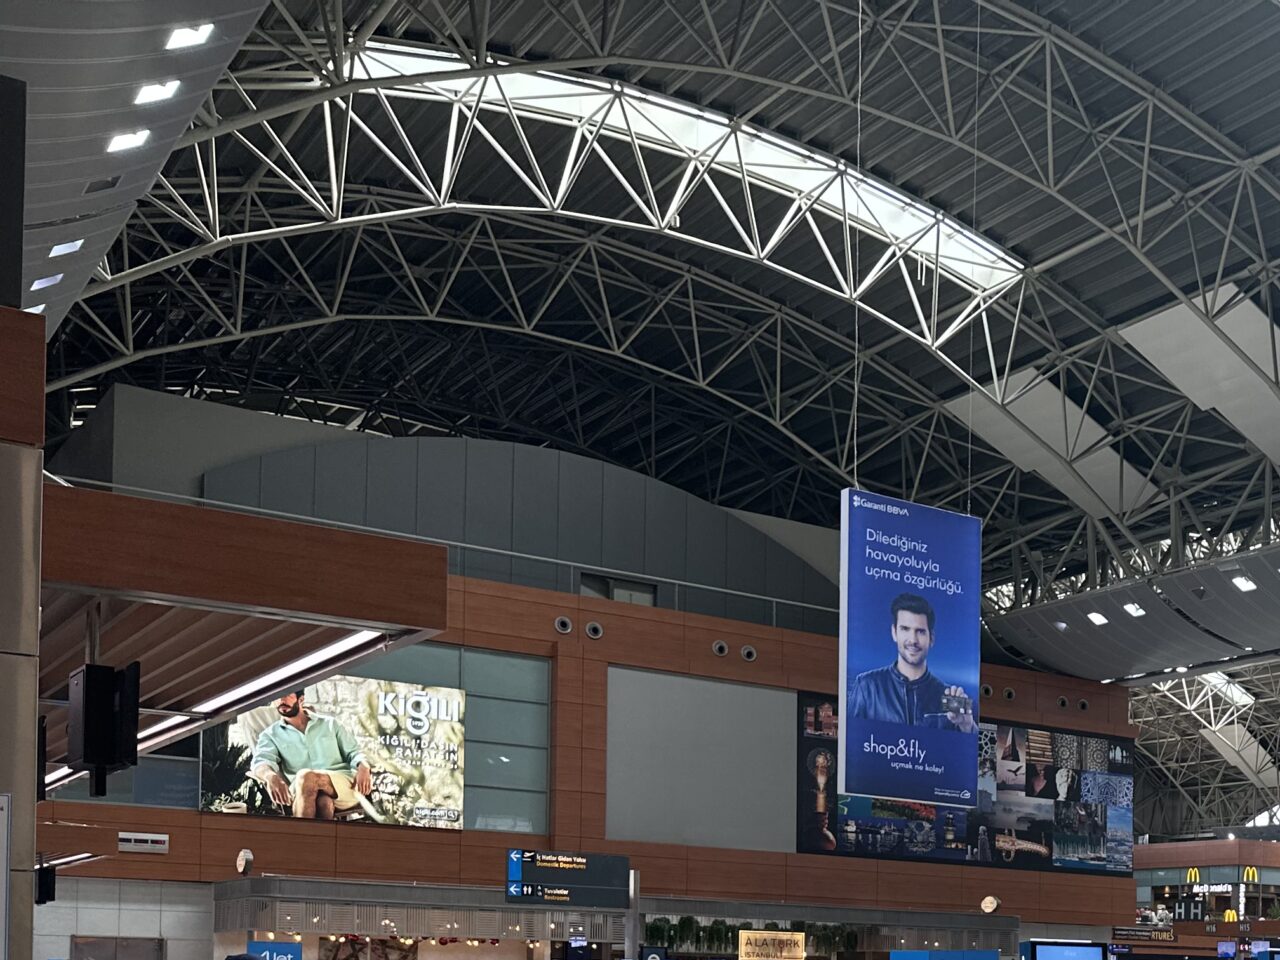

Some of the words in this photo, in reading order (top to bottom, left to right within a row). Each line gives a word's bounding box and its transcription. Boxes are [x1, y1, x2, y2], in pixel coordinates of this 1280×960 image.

[860, 498, 886, 512] Garanti
[887, 505, 909, 516] BBVA
[866, 528, 928, 552] Dilediğiniz
[866, 546, 940, 573] havayoluyla
[865, 566, 900, 581] uçma
[904, 572, 964, 595] özgürlüğü.
[864, 734, 926, 763] shop&fly
[925, 764, 944, 774] kolay!
